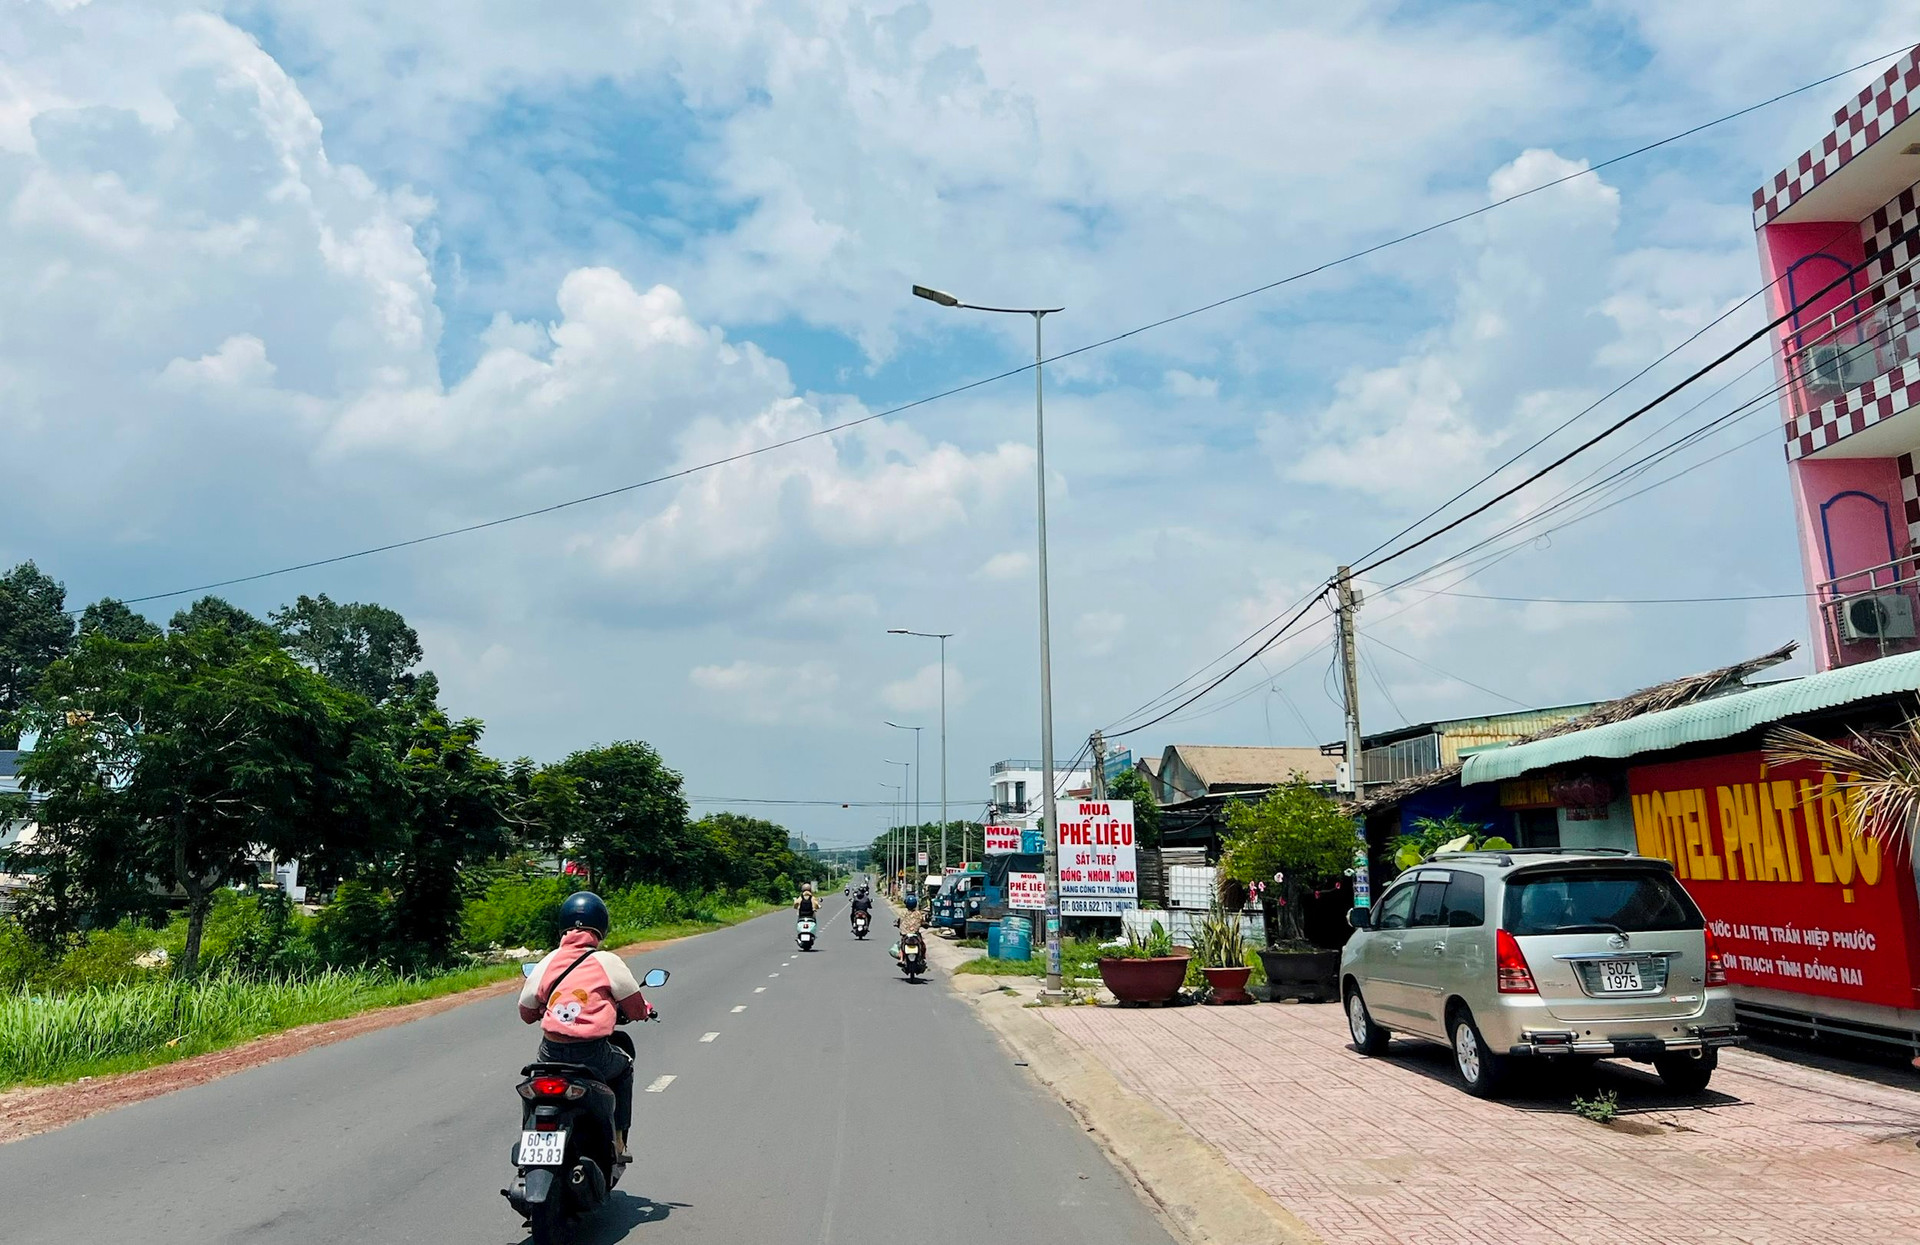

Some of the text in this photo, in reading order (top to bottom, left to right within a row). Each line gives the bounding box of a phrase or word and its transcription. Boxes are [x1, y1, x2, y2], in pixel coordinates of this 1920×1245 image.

[1079, 803, 1111, 816] MUA
[986, 827, 1020, 836] MUA
[1059, 816, 1133, 850] PHẾ LIỆU
[1631, 761, 1882, 904] MOTEL PHÁT LỘC
[1116, 870, 1135, 882] INOX
[1071, 900, 1112, 912] 0368.622.179
[1733, 923, 1750, 940] LAI
[1751, 925, 1769, 945] THỊ
[1770, 921, 1802, 945] TRẤN
[1802, 926, 1830, 951] HIỆP
[1832, 928, 1876, 951] PHƯỚC
[1607, 963, 1632, 975] 50Z
[1721, 951, 1864, 986] ƠN TRẠCH TỈNH ĐỒNG NAI
[1607, 975, 1638, 989] 1975
[520, 1148, 562, 1163] 435.83
